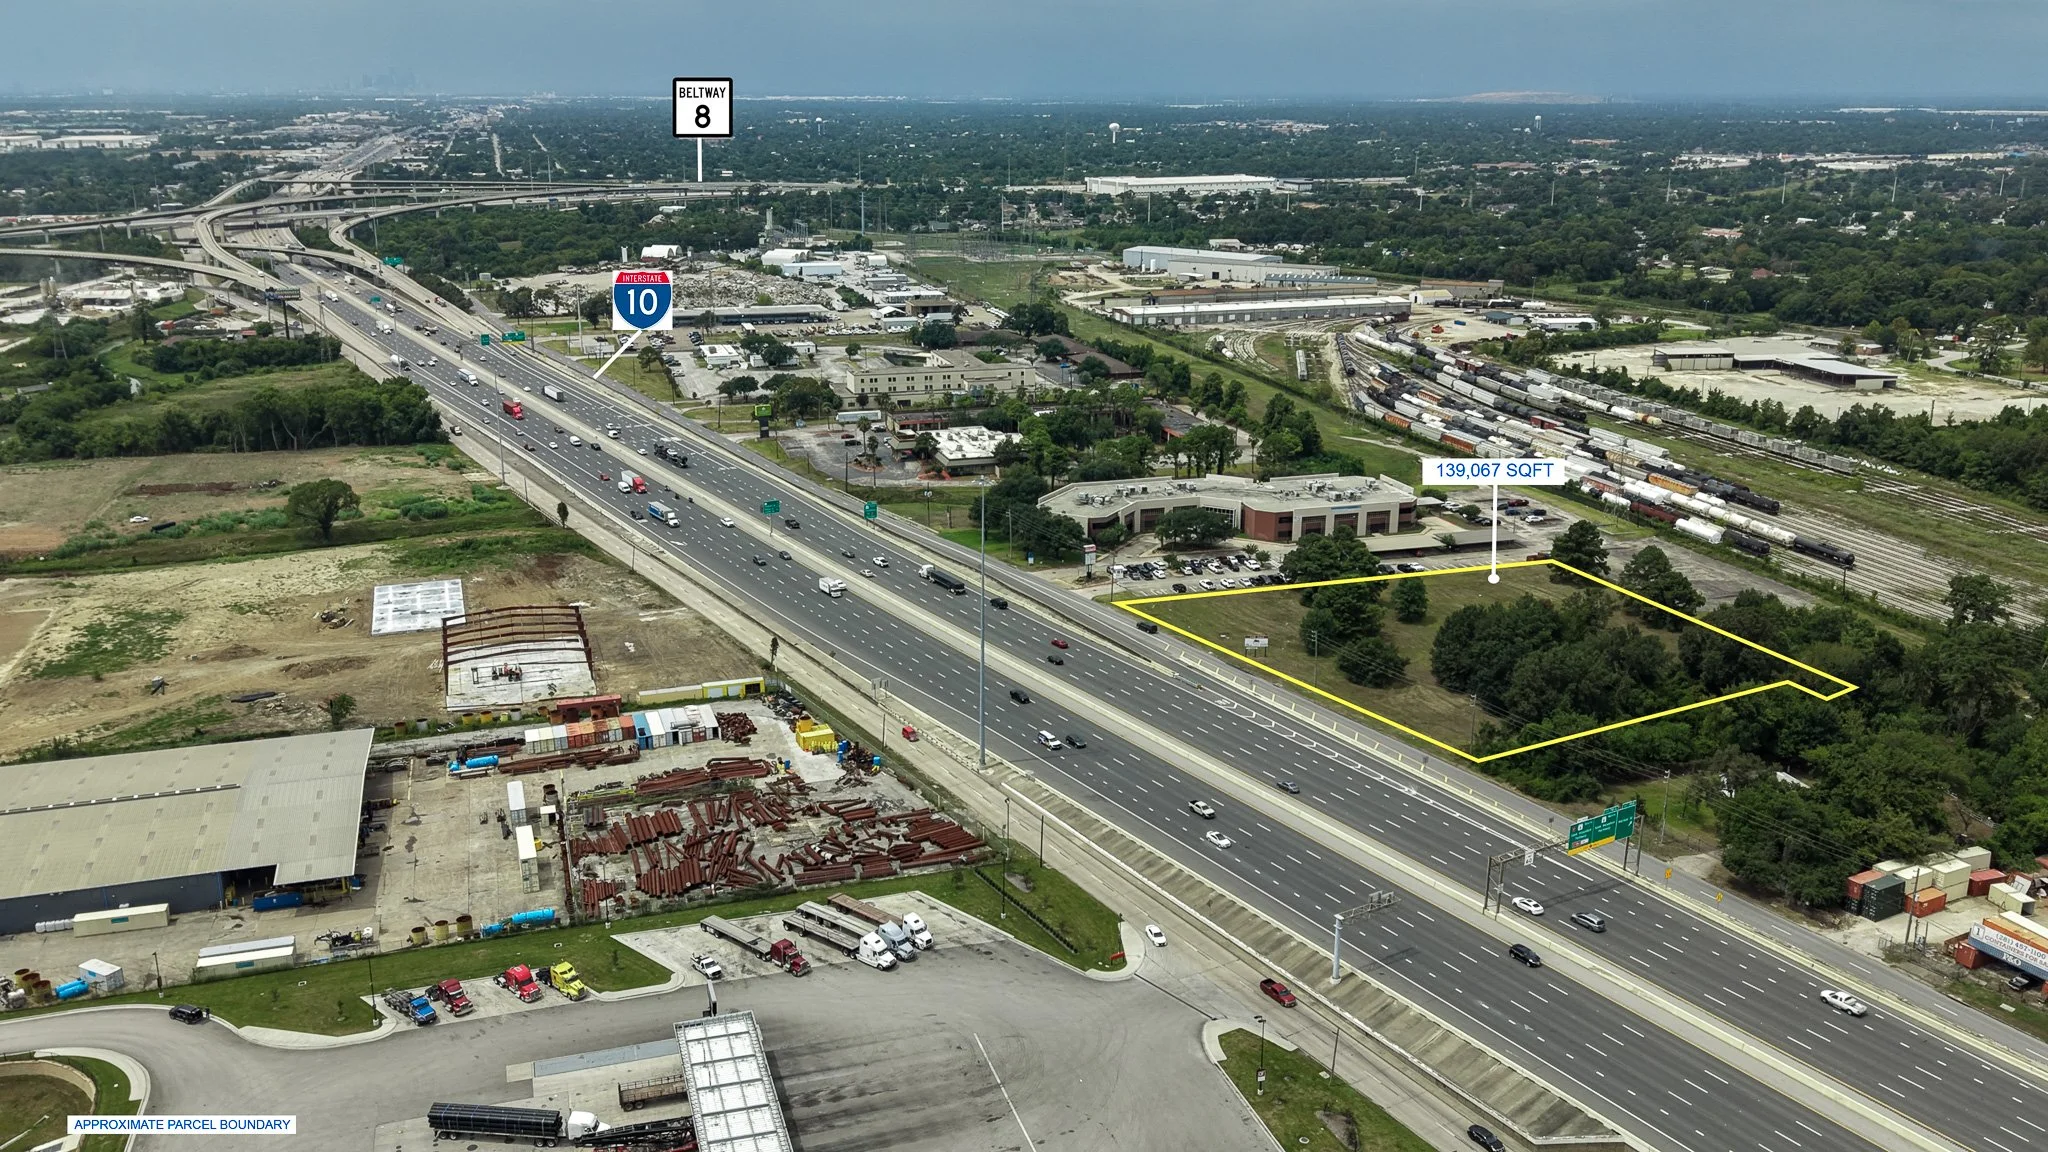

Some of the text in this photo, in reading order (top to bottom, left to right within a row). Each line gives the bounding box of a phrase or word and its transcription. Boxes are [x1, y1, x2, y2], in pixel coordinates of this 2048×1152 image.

[1984, 935, 2025, 957] CONTAINERS
[2025, 953, 2038, 963] FOR
[1996, 933, 2047, 960] (281) 457-1100
